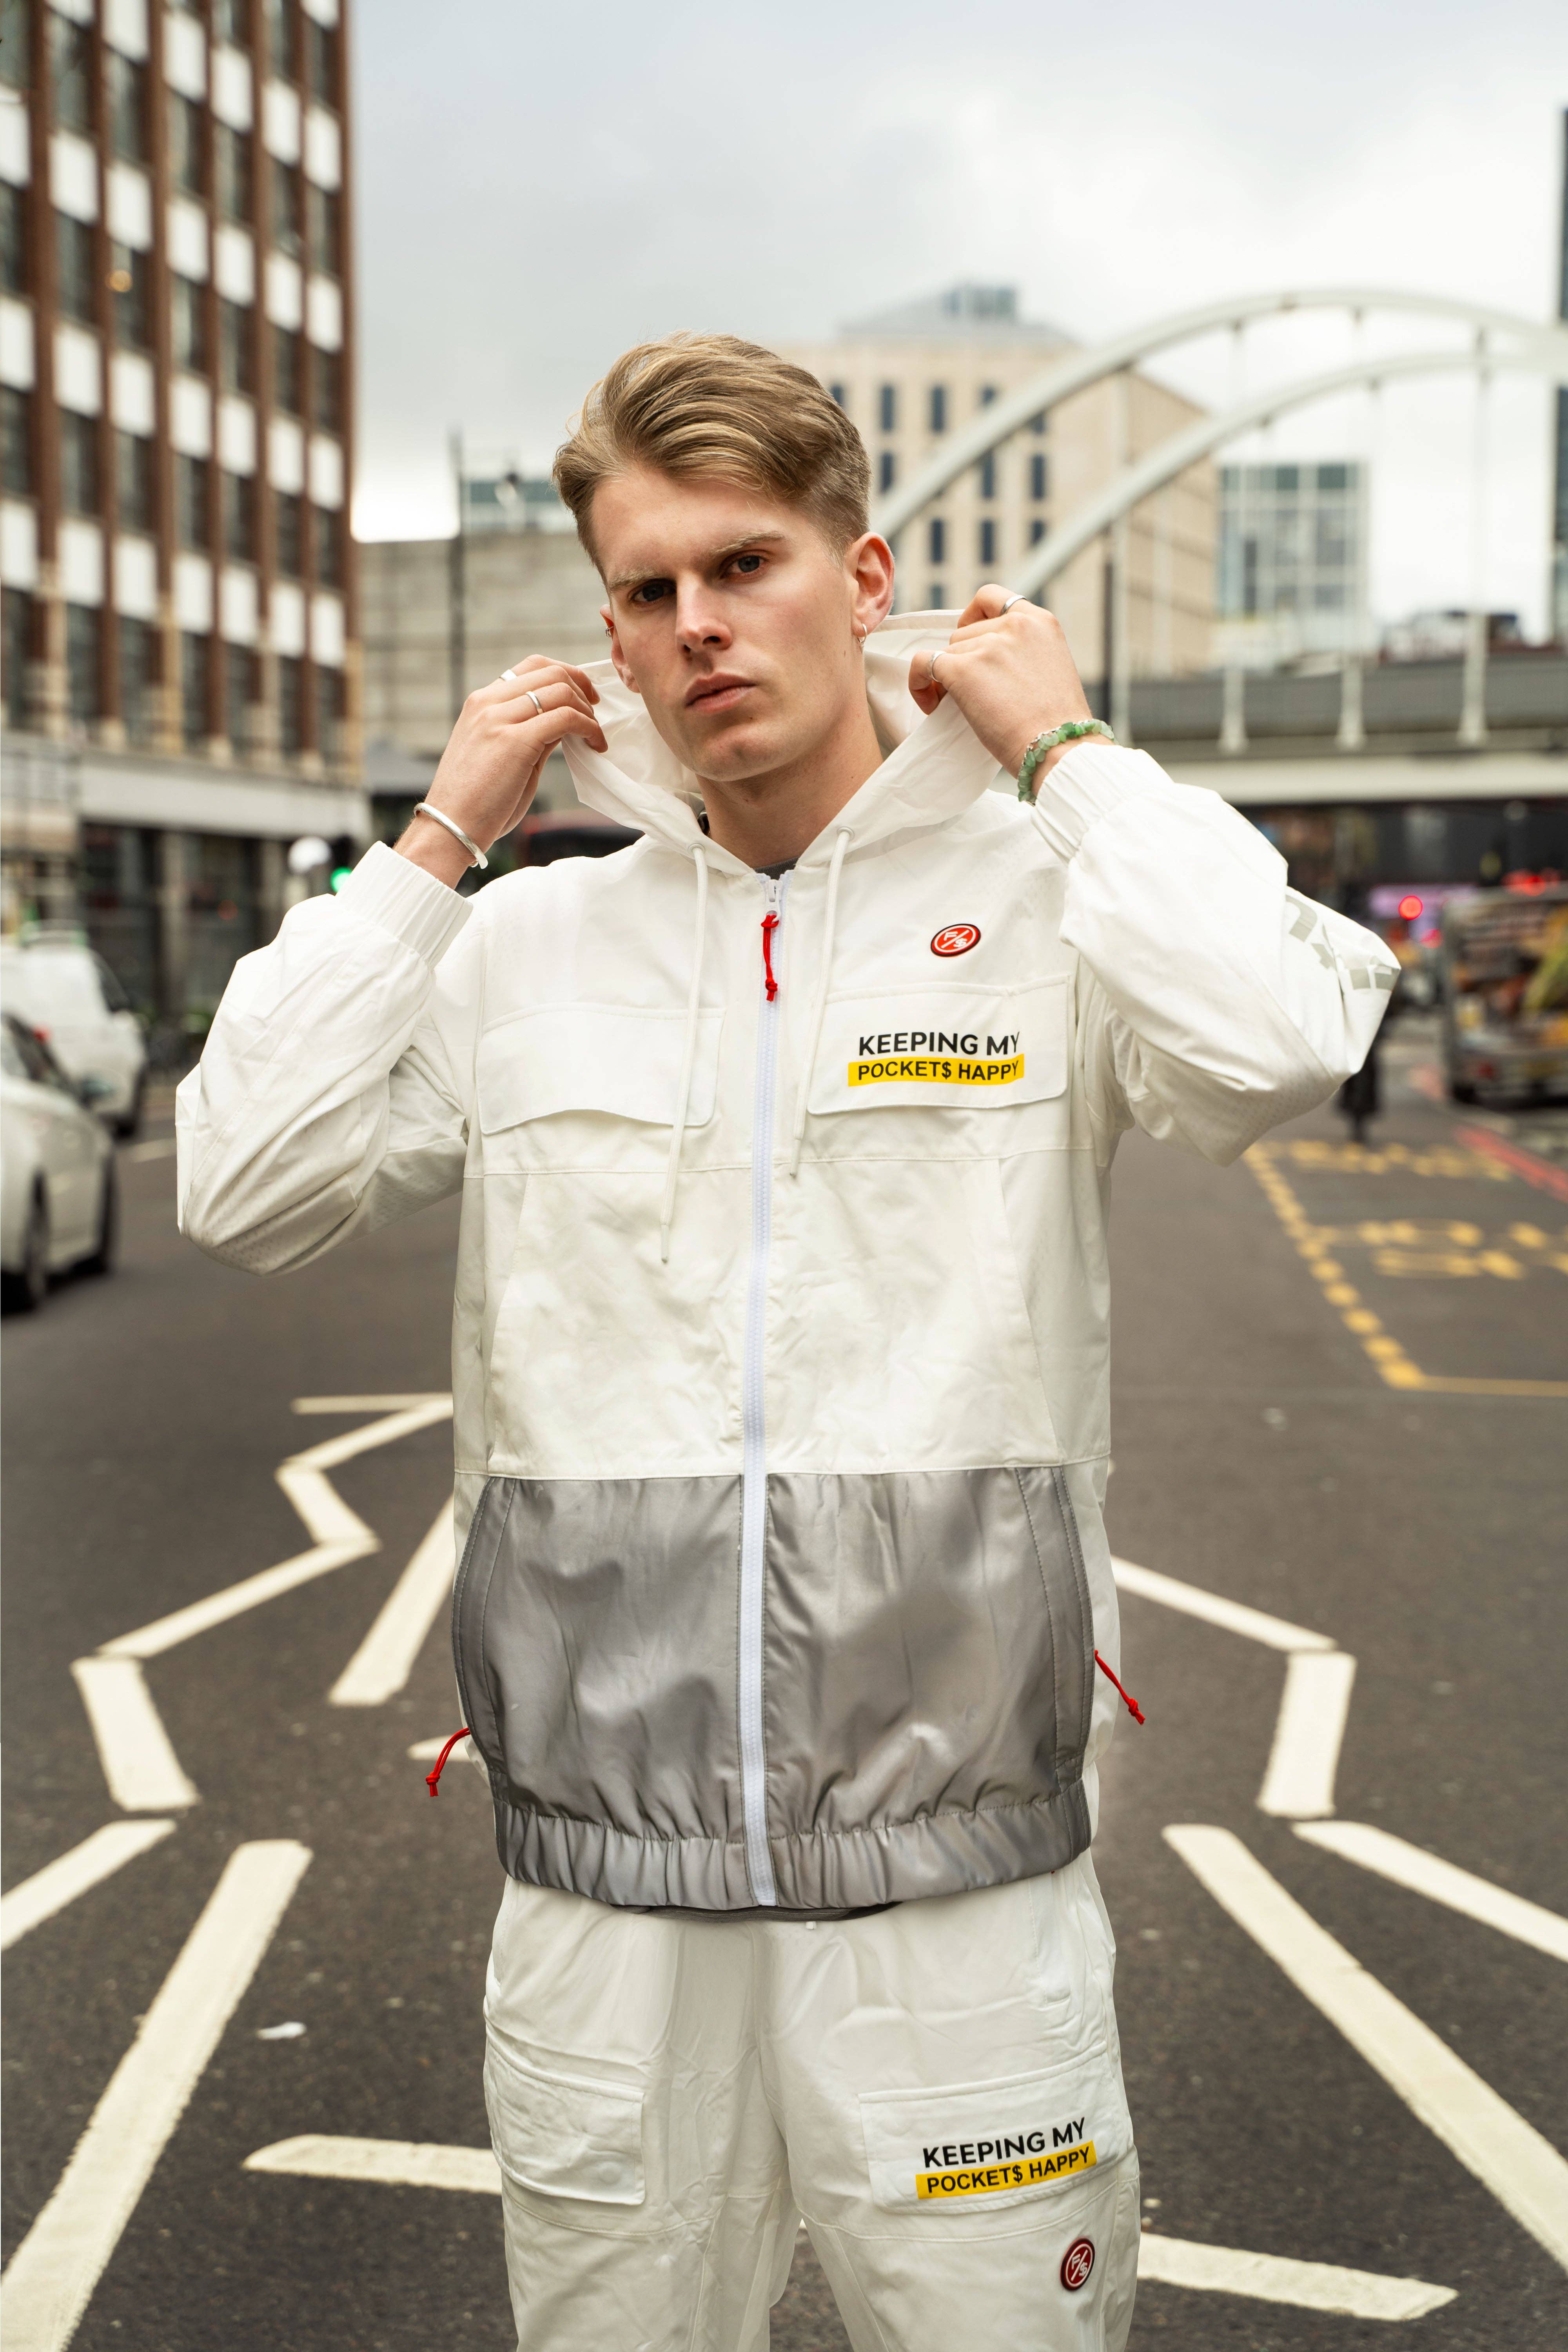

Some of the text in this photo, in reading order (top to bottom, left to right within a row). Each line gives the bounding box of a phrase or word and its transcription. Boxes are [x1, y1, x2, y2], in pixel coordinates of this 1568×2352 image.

[859, 1031, 1020, 1056] KEEPING MY
[858, 1060, 1019, 1080] POCKET$ HAPPY
[922, 2117, 1085, 2168] KEEPING MY
[927, 2146, 1090, 2193] POCKET$ HAPPY
